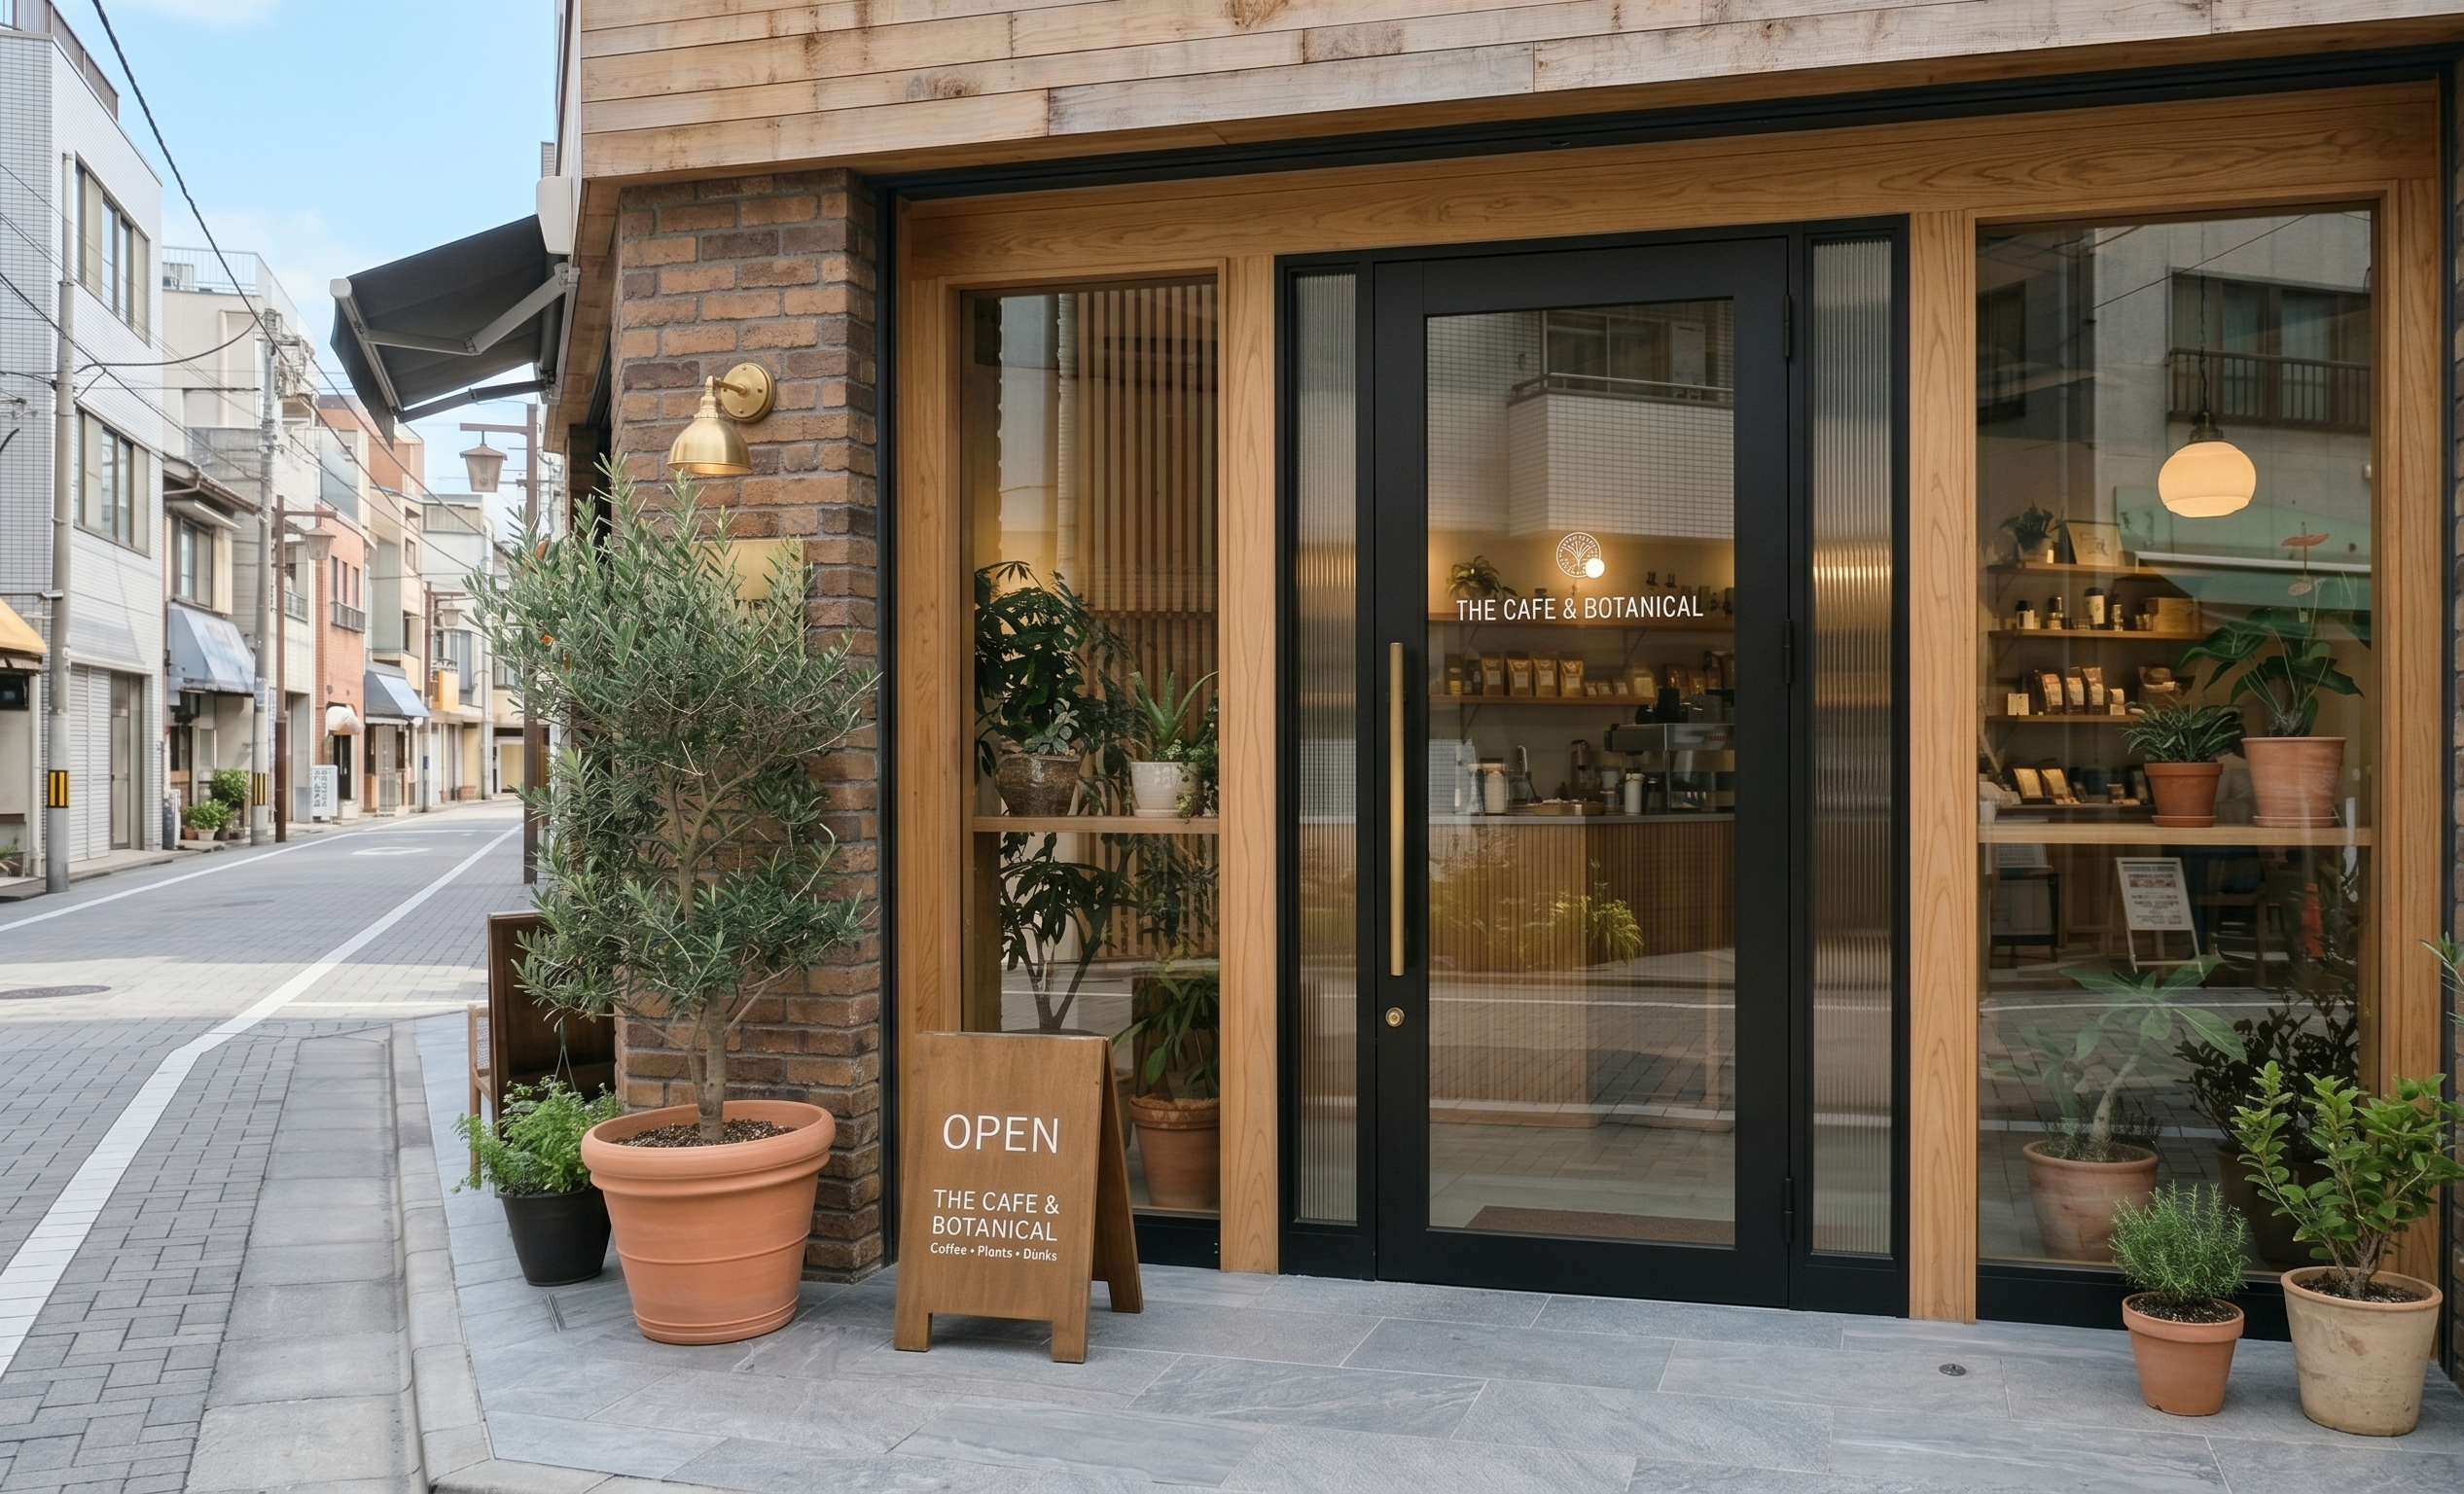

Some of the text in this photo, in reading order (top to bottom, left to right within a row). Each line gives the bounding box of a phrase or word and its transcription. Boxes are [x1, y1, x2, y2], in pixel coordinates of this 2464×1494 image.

[1455, 595, 1704, 622] THE CAFE & BOTANICAL
[942, 1113, 1059, 1155] OPEN
[933, 1189, 1060, 1215] THE CAFE &
[931, 1215, 1058, 1242] BOTANICAL
[930, 1241, 968, 1256] Coffee
[977, 1244, 1013, 1259] Plants
